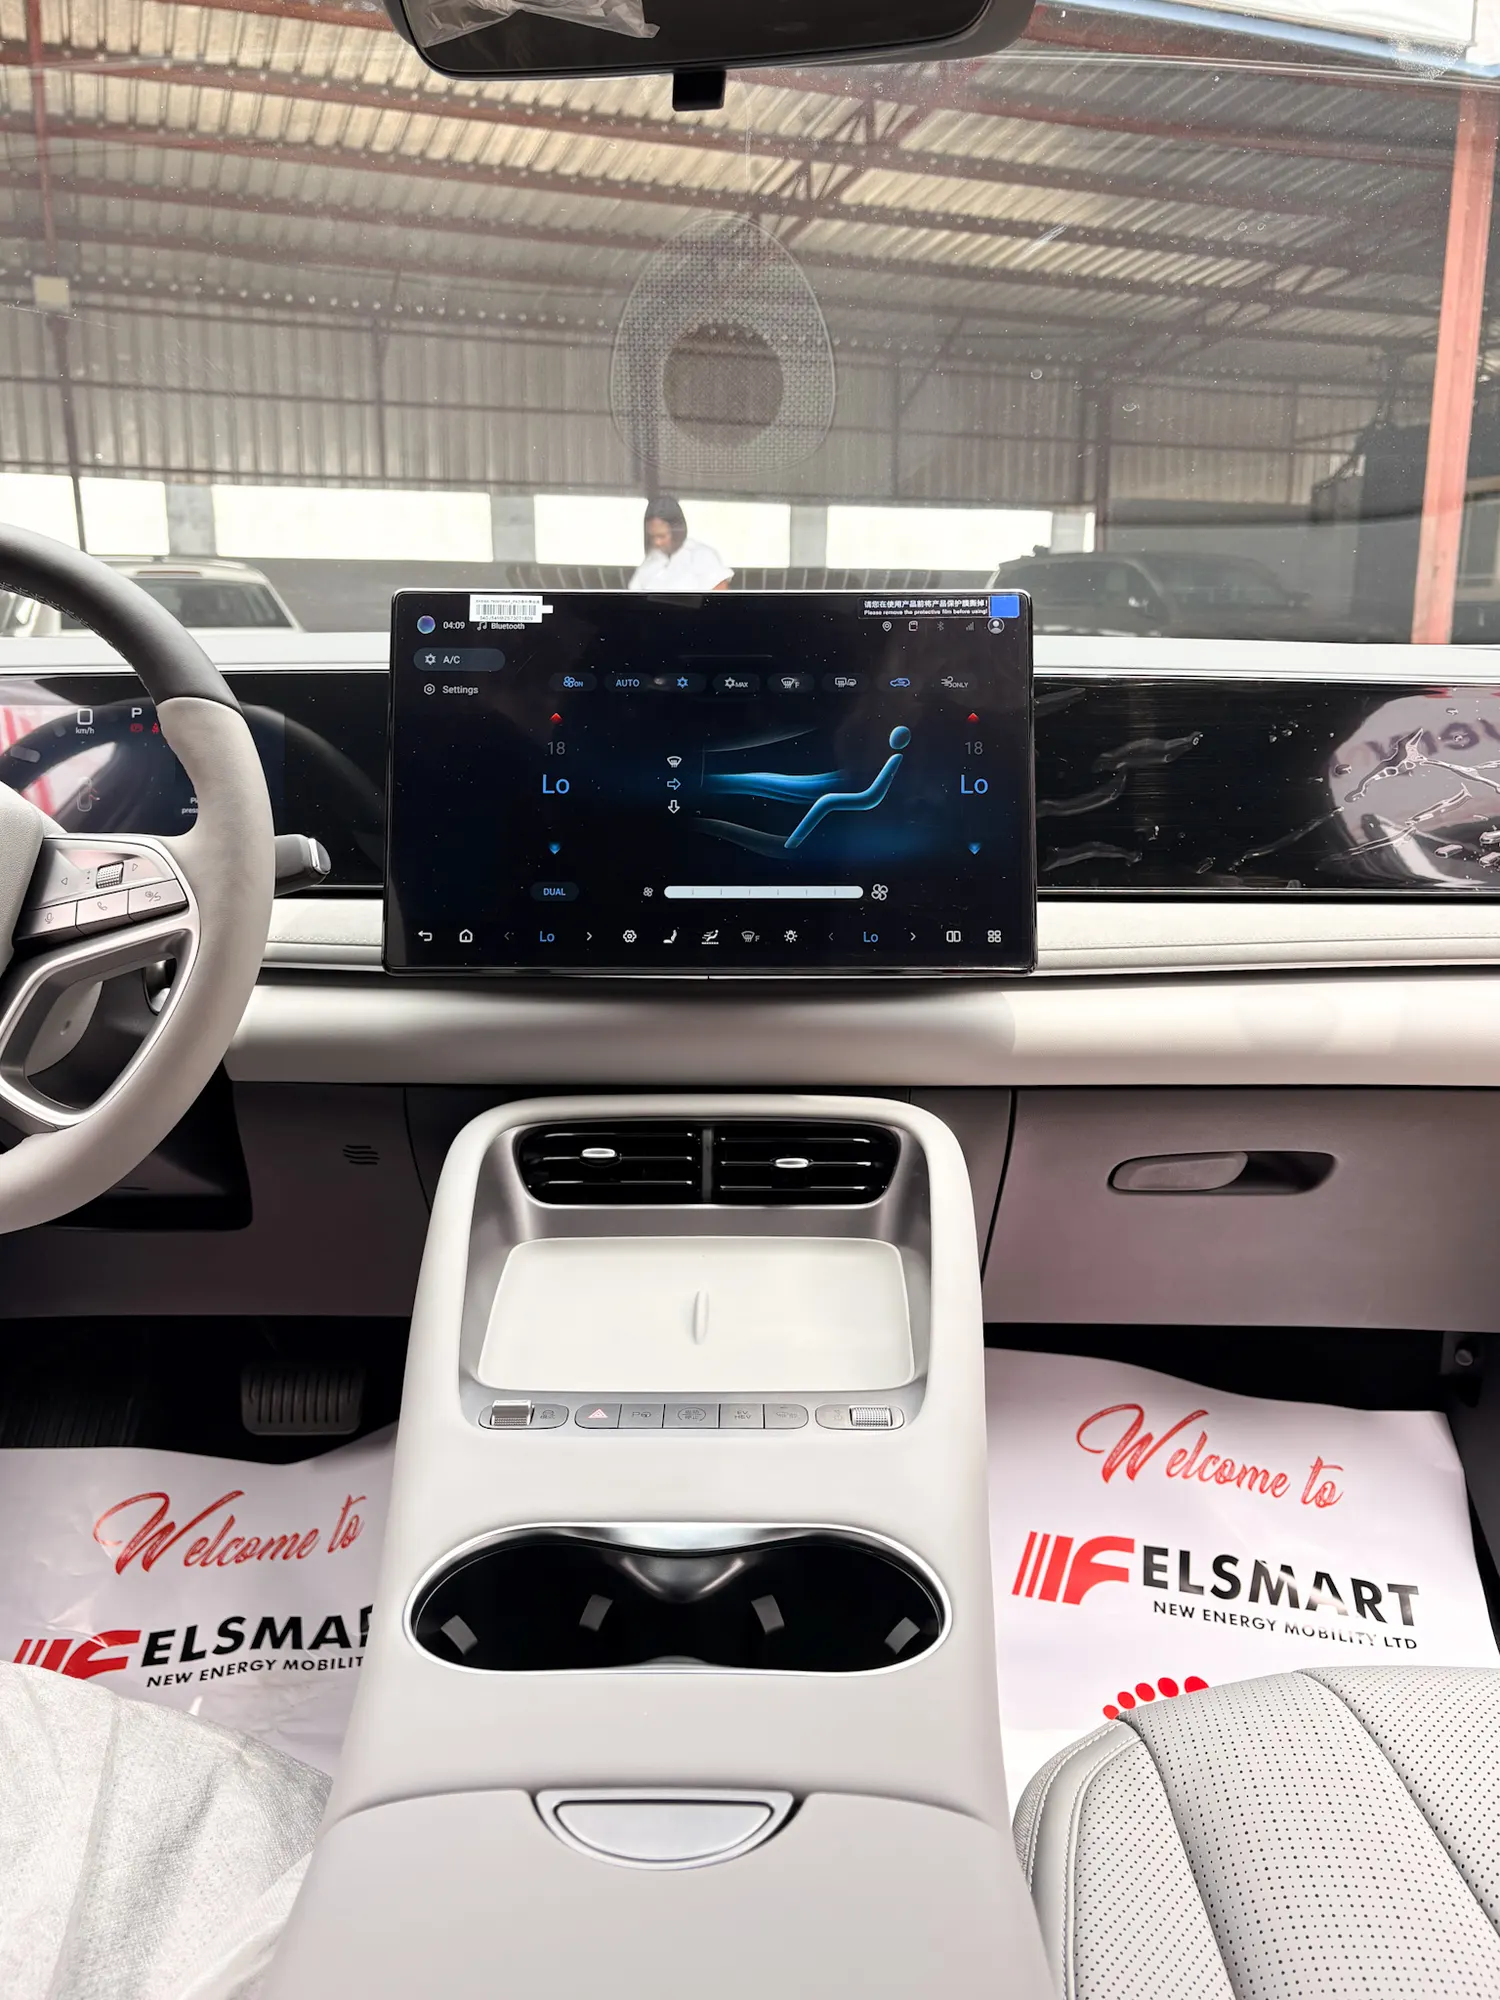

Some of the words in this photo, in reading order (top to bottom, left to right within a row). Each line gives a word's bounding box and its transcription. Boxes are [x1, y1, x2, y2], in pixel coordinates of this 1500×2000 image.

[443, 621, 466, 630] 04:09
[491, 622, 525, 630] Bluetooth
[443, 655, 461, 665] A/C
[616, 679, 640, 688] AUTO
[735, 680, 749, 688] MAX
[952, 680, 969, 688] ONLY
[442, 685, 479, 696] Settings
[77, 708, 93, 725] 0
[131, 707, 142, 718] P
[75, 727, 95, 735] km/h
[547, 741, 566, 755] 18
[964, 741, 983, 755] 18
[542, 774, 570, 794] Lo
[960, 774, 989, 794] Lo
[543, 888, 566, 896] DUAL
[539, 931, 555, 942] Lo
[863, 931, 879, 942] Lo
[1076, 1403, 1290, 1498] Welcome
[1300, 1456, 1344, 1508] to
[93, 1490, 320, 1575] Welcome
[327, 1494, 366, 1554] to
[1154, 1600, 1195, 1619] NEW
[1203, 1609, 1277, 1632] ENERGY
[1285, 1622, 1377, 1647] MOBILITY
[1383, 1634, 1418, 1650] LTD
[146, 1673, 193, 1688] NEW
[200, 1659, 276, 1682] ENERGY
[282, 1655, 363, 1671] MOBILIT
